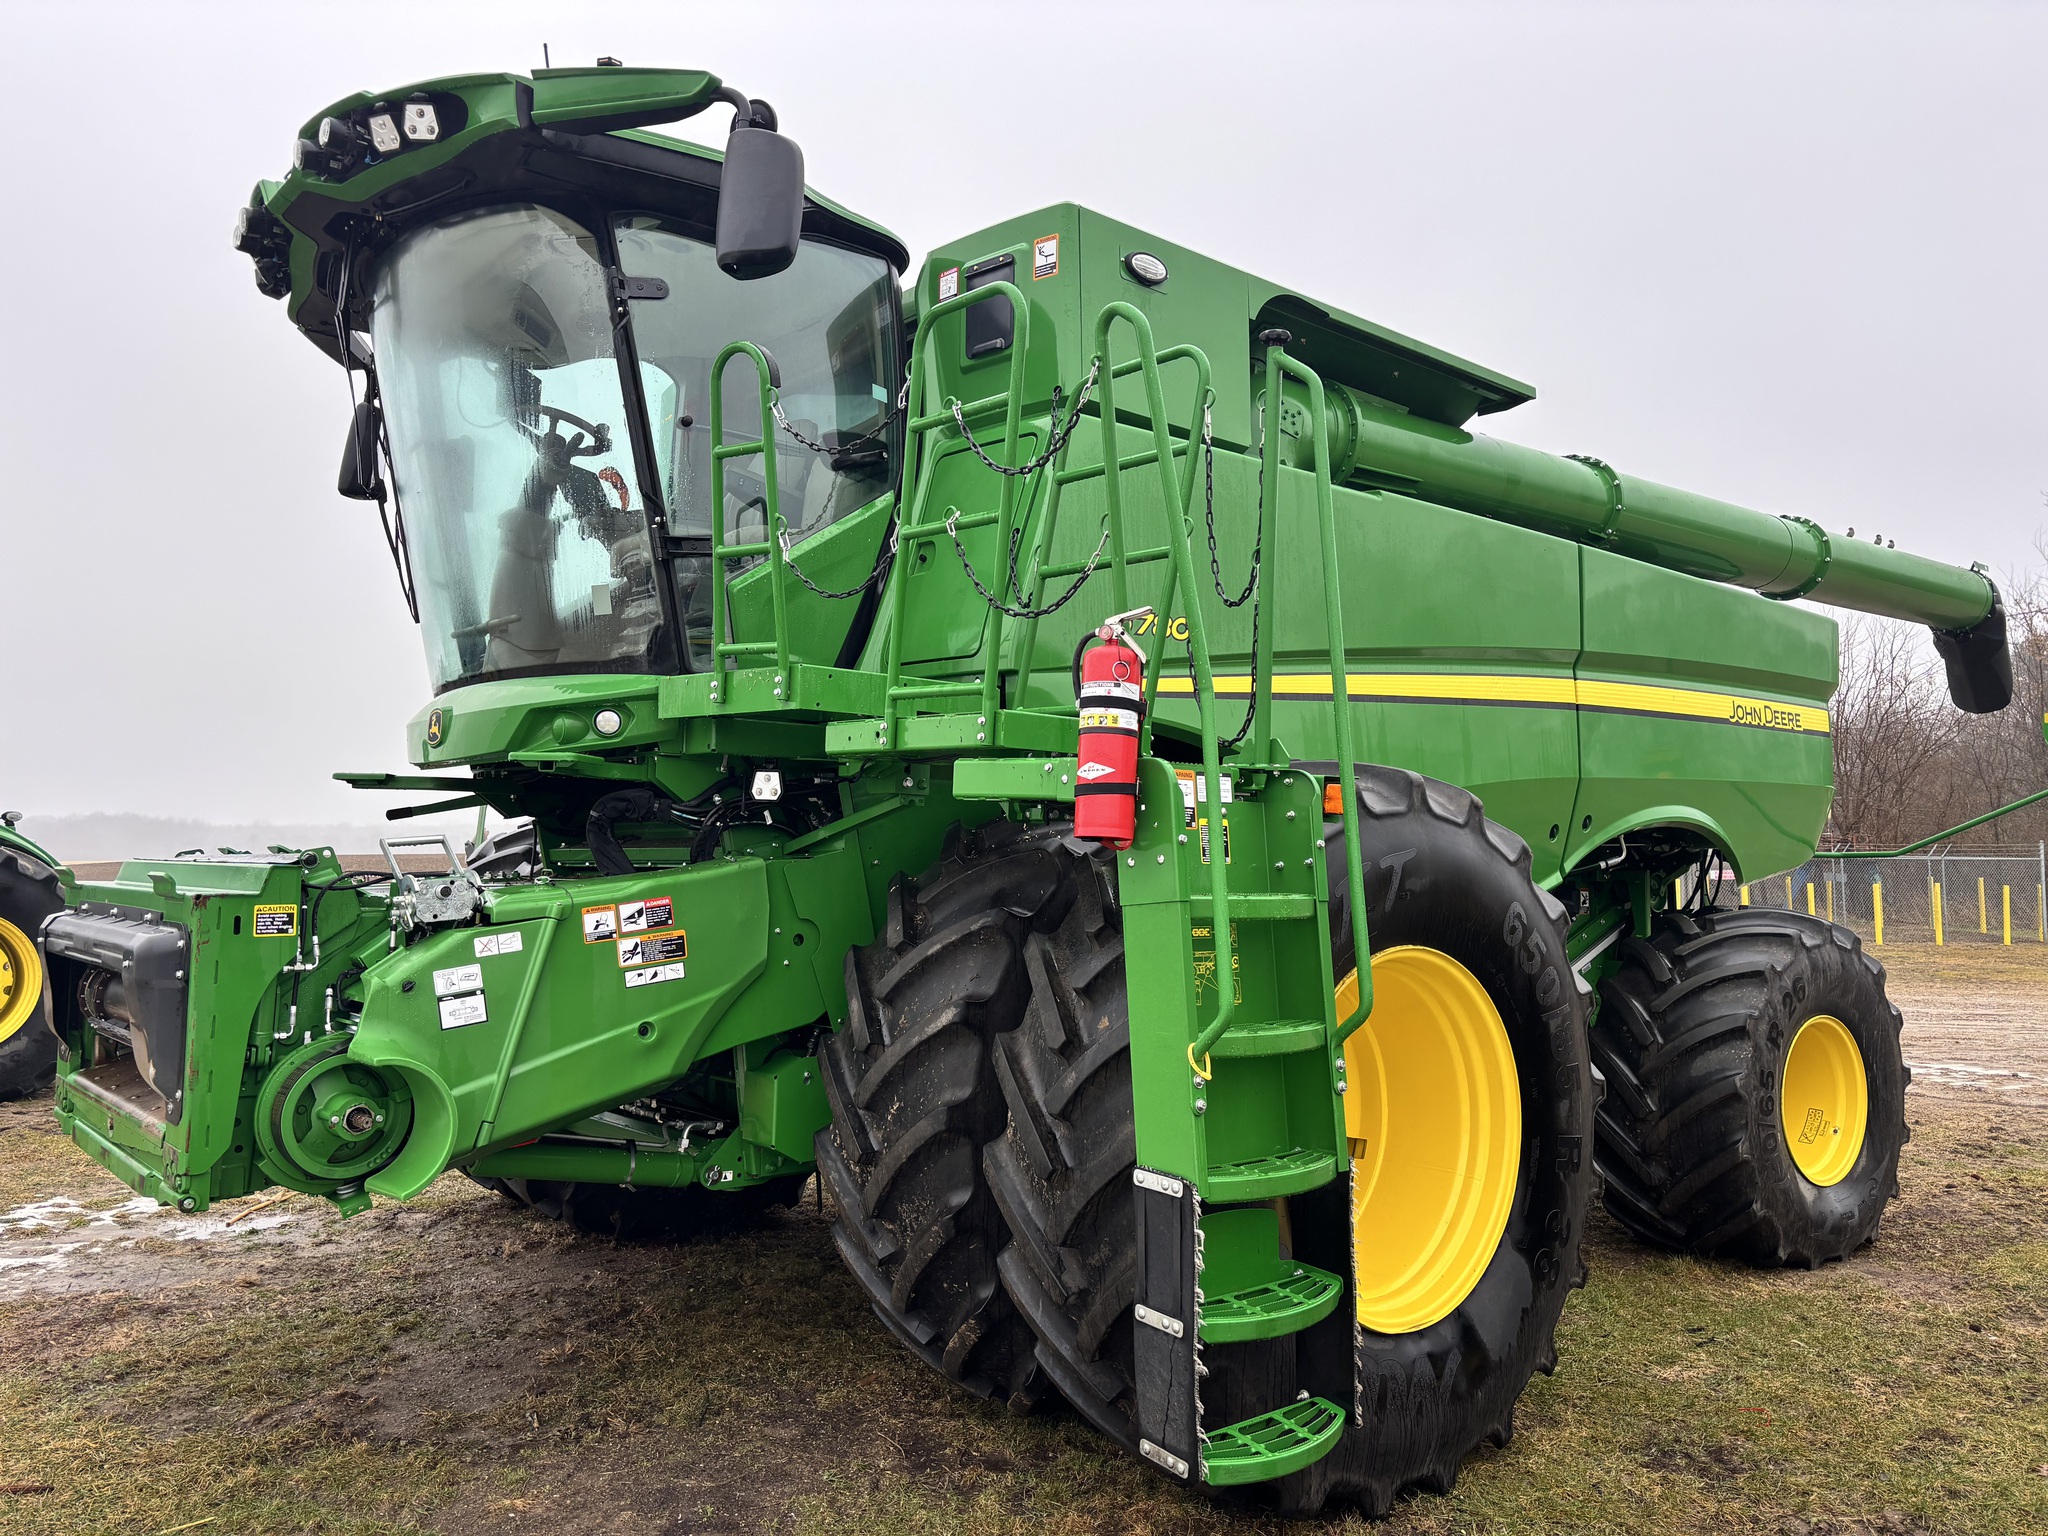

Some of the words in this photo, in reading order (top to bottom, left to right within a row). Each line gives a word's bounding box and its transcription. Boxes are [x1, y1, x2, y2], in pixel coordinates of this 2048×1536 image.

[1729, 700, 1763, 723] JOHN
[1764, 705, 1802, 729] DEERE
[591, 905, 612, 913] WARNING
[1766, 1019, 1785, 1053] R
[1781, 975, 1807, 1022] 26
[1556, 1134, 1583, 1174] R
[1533, 1208, 1572, 1291] 38
